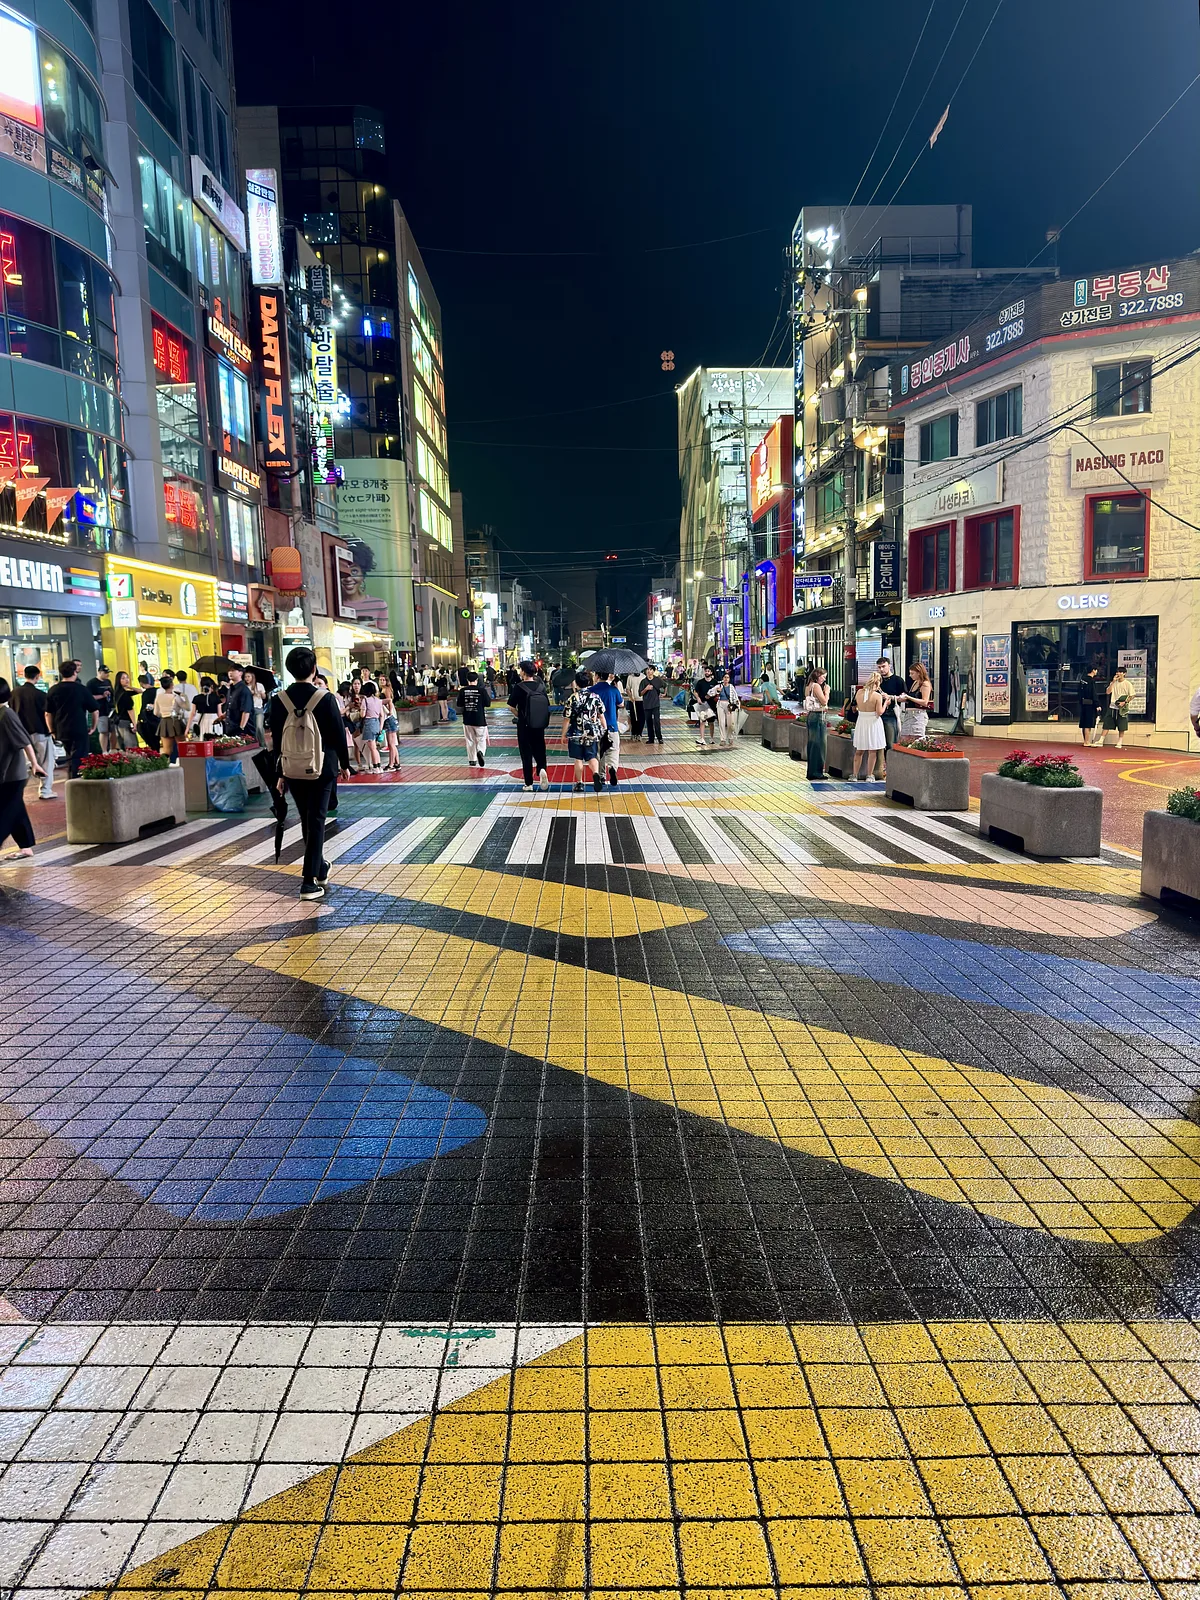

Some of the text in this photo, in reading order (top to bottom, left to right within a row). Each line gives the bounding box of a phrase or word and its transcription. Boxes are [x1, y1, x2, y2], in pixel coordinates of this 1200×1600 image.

[256, 202, 275, 279] 사격양궁장
[1076, 281, 1085, 305] 에이스
[1092, 265, 1170, 301] 부동산
[999, 299, 1025, 326] 상가전문
[1060, 305, 1112, 327] 상가전문
[1119, 293, 1184, 317] 322.7888
[208, 316, 234, 350] DART
[233, 335, 252, 363] FLEX
[985, 318, 1025, 352] 322.7888
[259, 294, 286, 456] DART FLEX
[316, 330, 335, 402] 방탈출
[911, 335, 970, 389] 공인중개사
[219, 457, 243, 482] DART
[242, 467, 261, 489] FLEX
[1076, 449, 1164, 472] NASUNG TACO
[363, 479, 389, 490] 8개층
[939, 489, 970, 511] 나성타코
[880, 551, 894, 588] 부동산
[1058, 594, 1109, 610] OLENS
